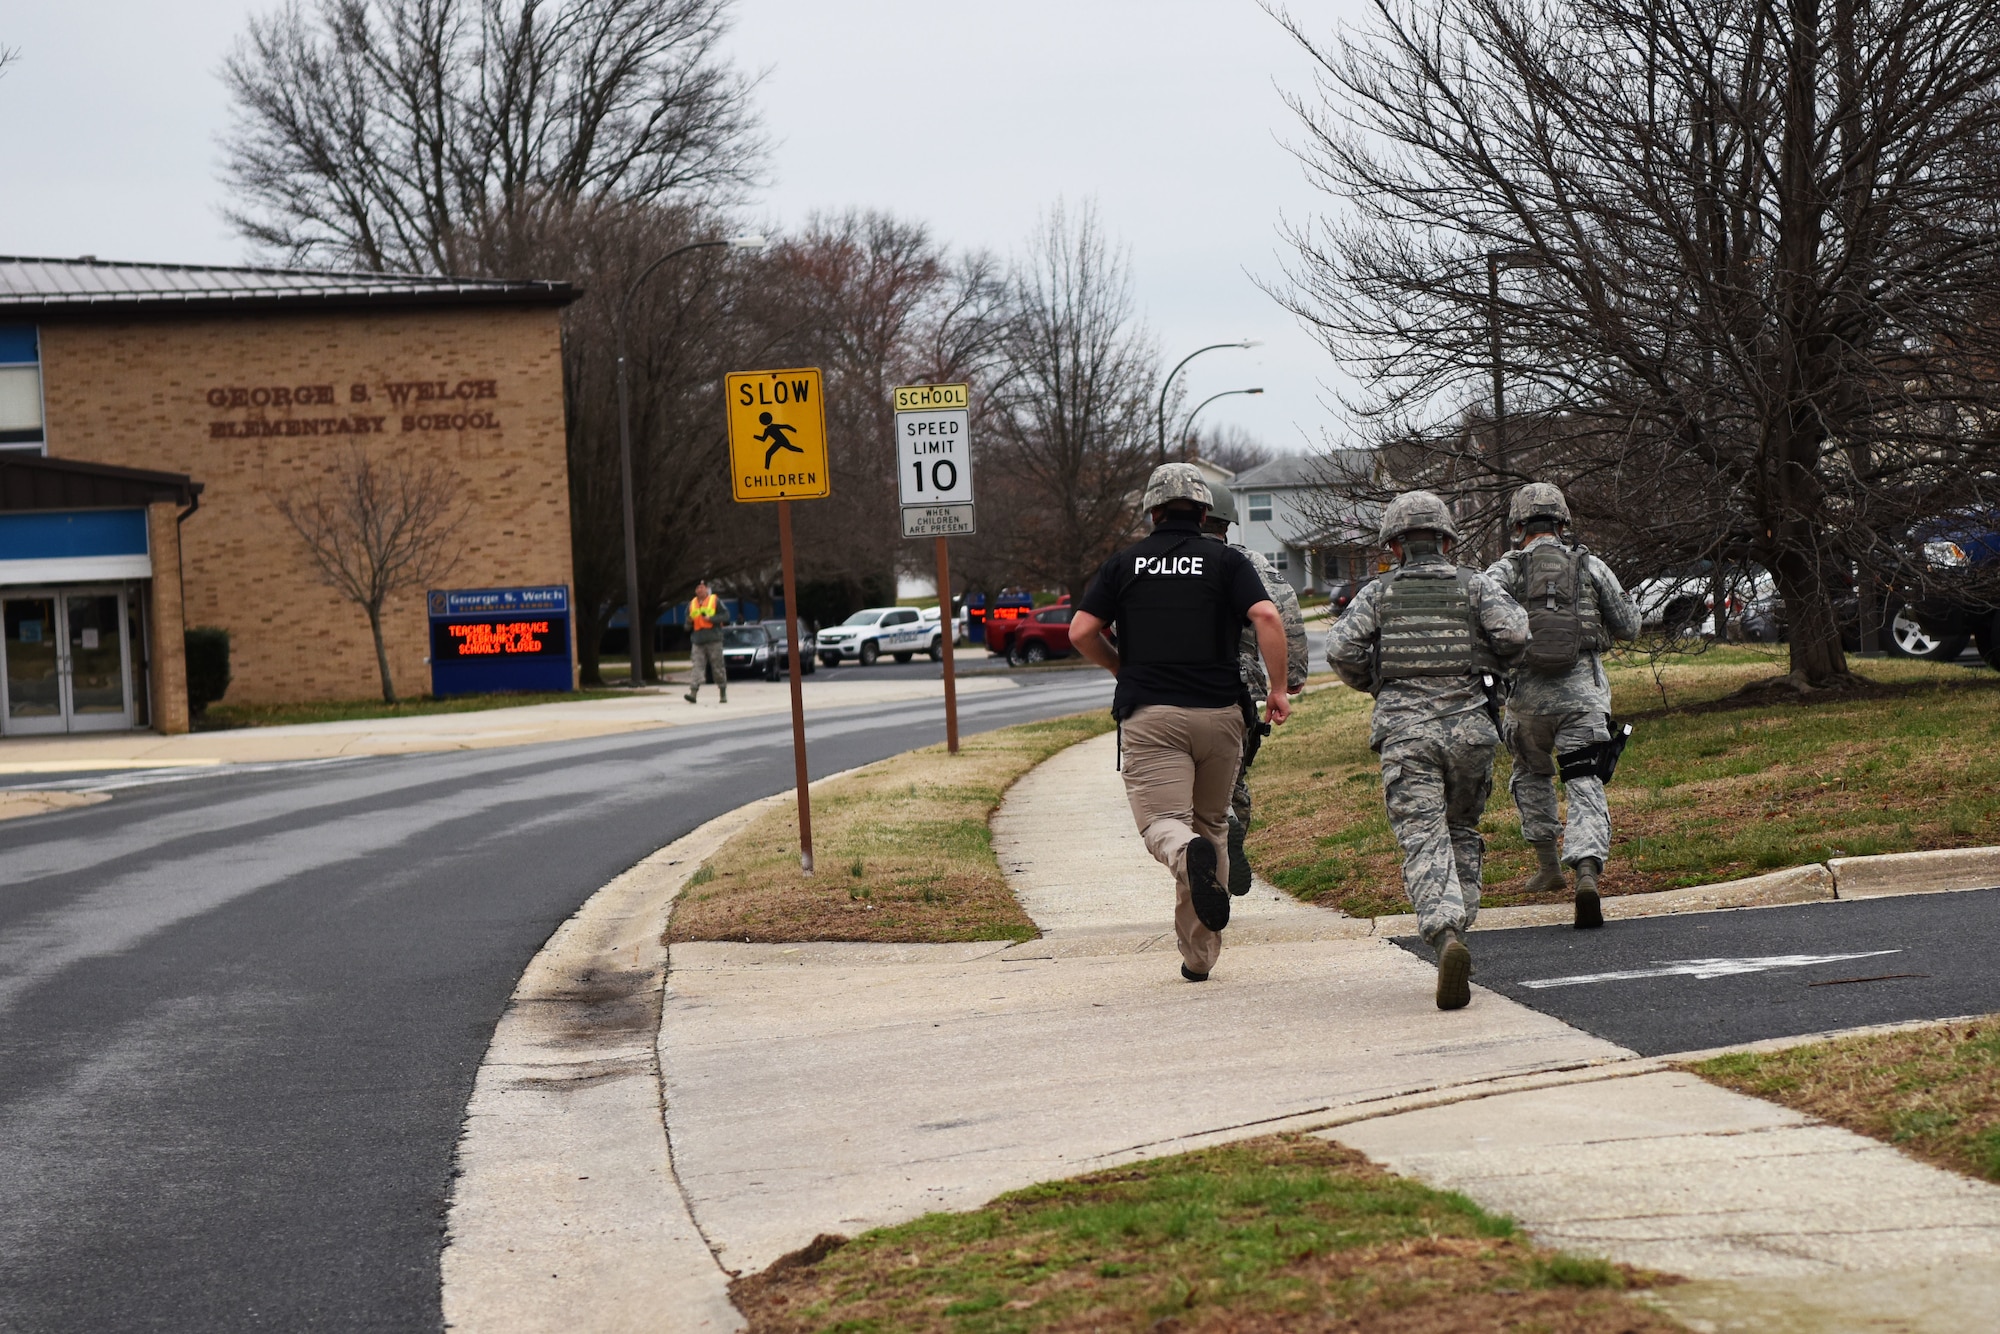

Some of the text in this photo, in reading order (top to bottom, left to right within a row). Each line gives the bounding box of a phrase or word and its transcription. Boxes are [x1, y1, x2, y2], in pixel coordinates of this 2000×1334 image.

[206, 380, 498, 408] GEORGE S. WELCH
[740, 380, 809, 406] SLOW
[899, 390, 964, 405] SCHOOL
[209, 412, 501, 438] ELEMENTARY SCHOOL
[907, 421, 959, 436] SPEED
[913, 440, 955, 455] LIMIT
[745, 473, 816, 488] CHILDREN
[912, 459, 957, 492] 10
[925, 508, 950, 517] WHEN
[917, 516, 960, 525] CHILDREN
[909, 523, 969, 534] ARE PRESENT
[1134, 556, 1204, 575] POLICE
[450, 594, 499, 605] George
[522, 590, 563, 601] Welch
[448, 622, 549, 637] TEACHER IN-SERVICE
[466, 633, 515, 644] FEBRUARY
[458, 640, 542, 655] SCHOOLS CLOSED
